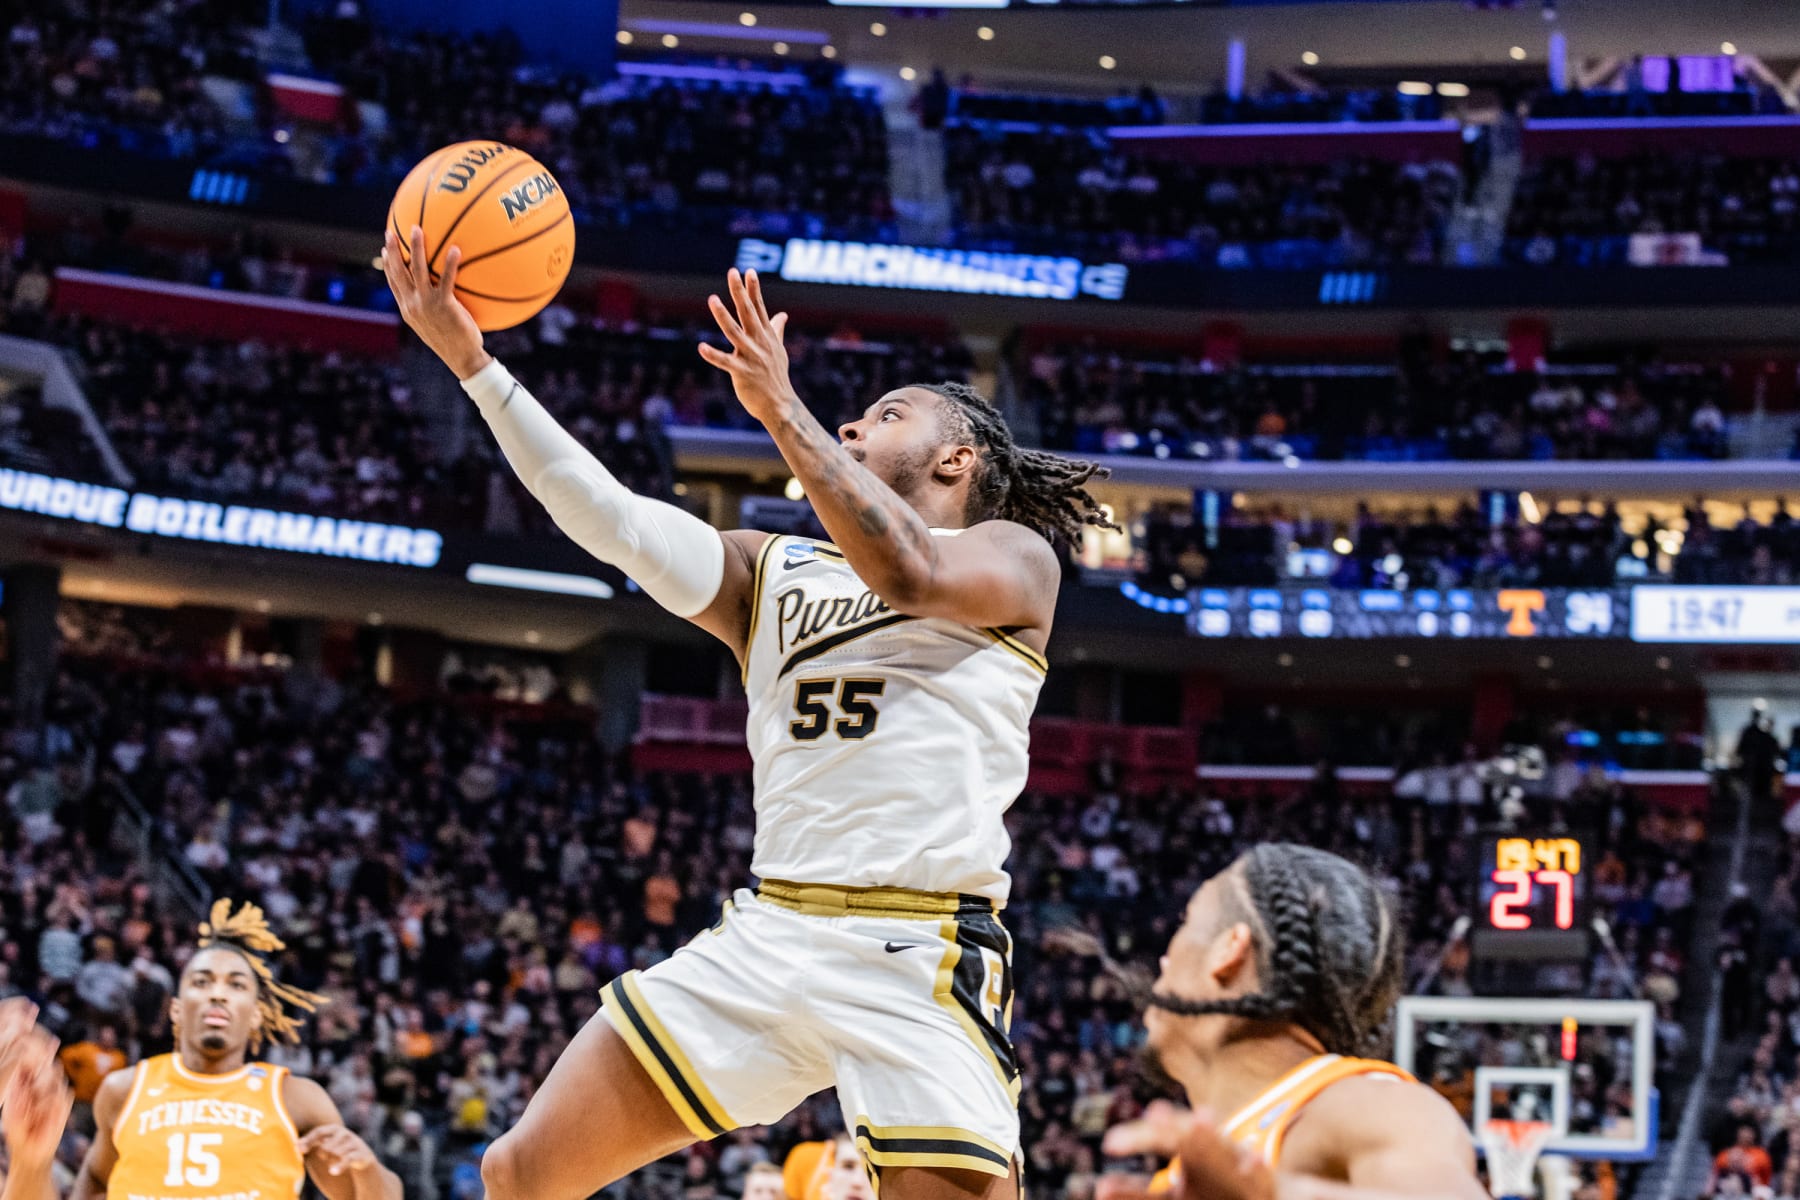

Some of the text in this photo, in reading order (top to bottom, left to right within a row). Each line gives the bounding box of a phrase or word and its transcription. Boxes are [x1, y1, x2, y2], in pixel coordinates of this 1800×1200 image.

[499, 172, 560, 222] NCAA
[783, 239, 1081, 299] MARCH MADNESS
[0, 468, 442, 567] URDUE BOILERMAKERS
[788, 678, 887, 742] 55
[1490, 869, 1574, 930] 27
[138, 1098, 264, 1136] TENNESSEE
[163, 1132, 223, 1187] 15
